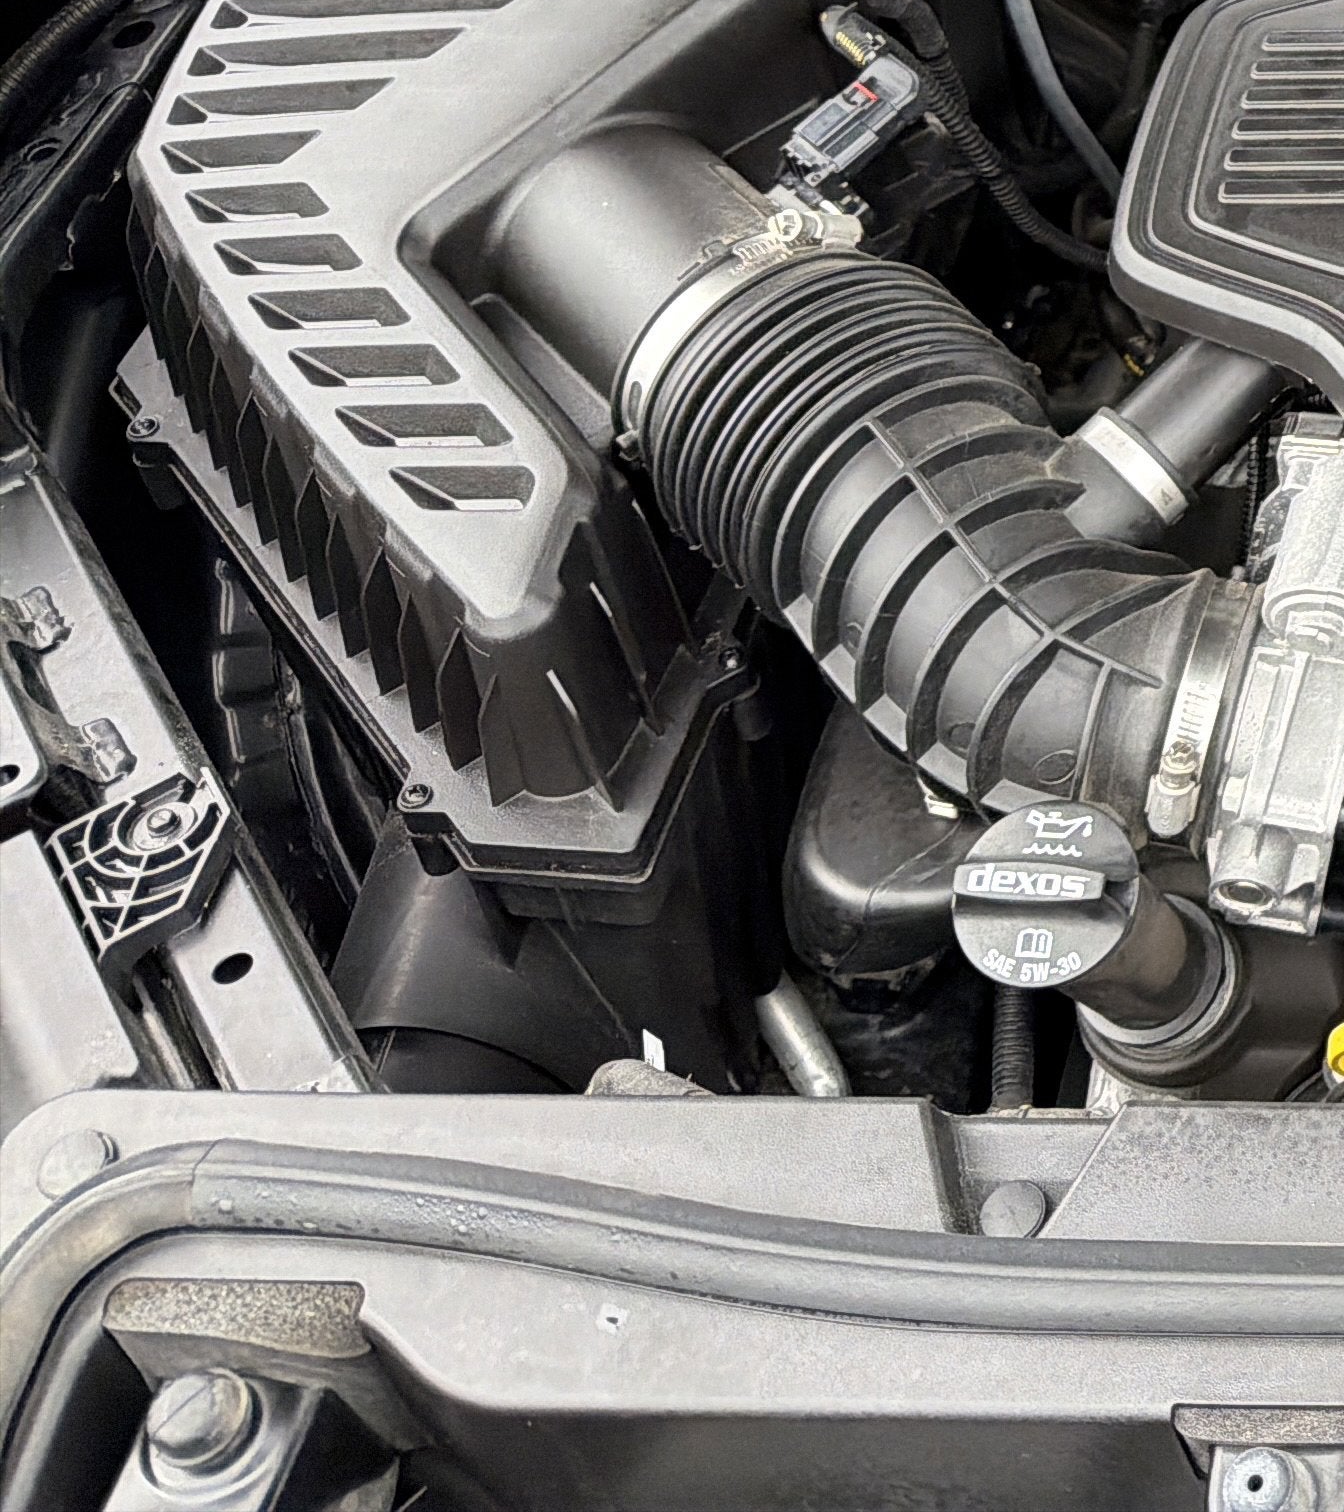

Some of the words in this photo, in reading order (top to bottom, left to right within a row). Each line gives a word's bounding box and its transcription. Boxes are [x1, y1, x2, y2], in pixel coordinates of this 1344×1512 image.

[967, 863, 1091, 898] dexos
[983, 949, 1017, 978] SAE
[1019, 952, 1082, 981] 5W-30
